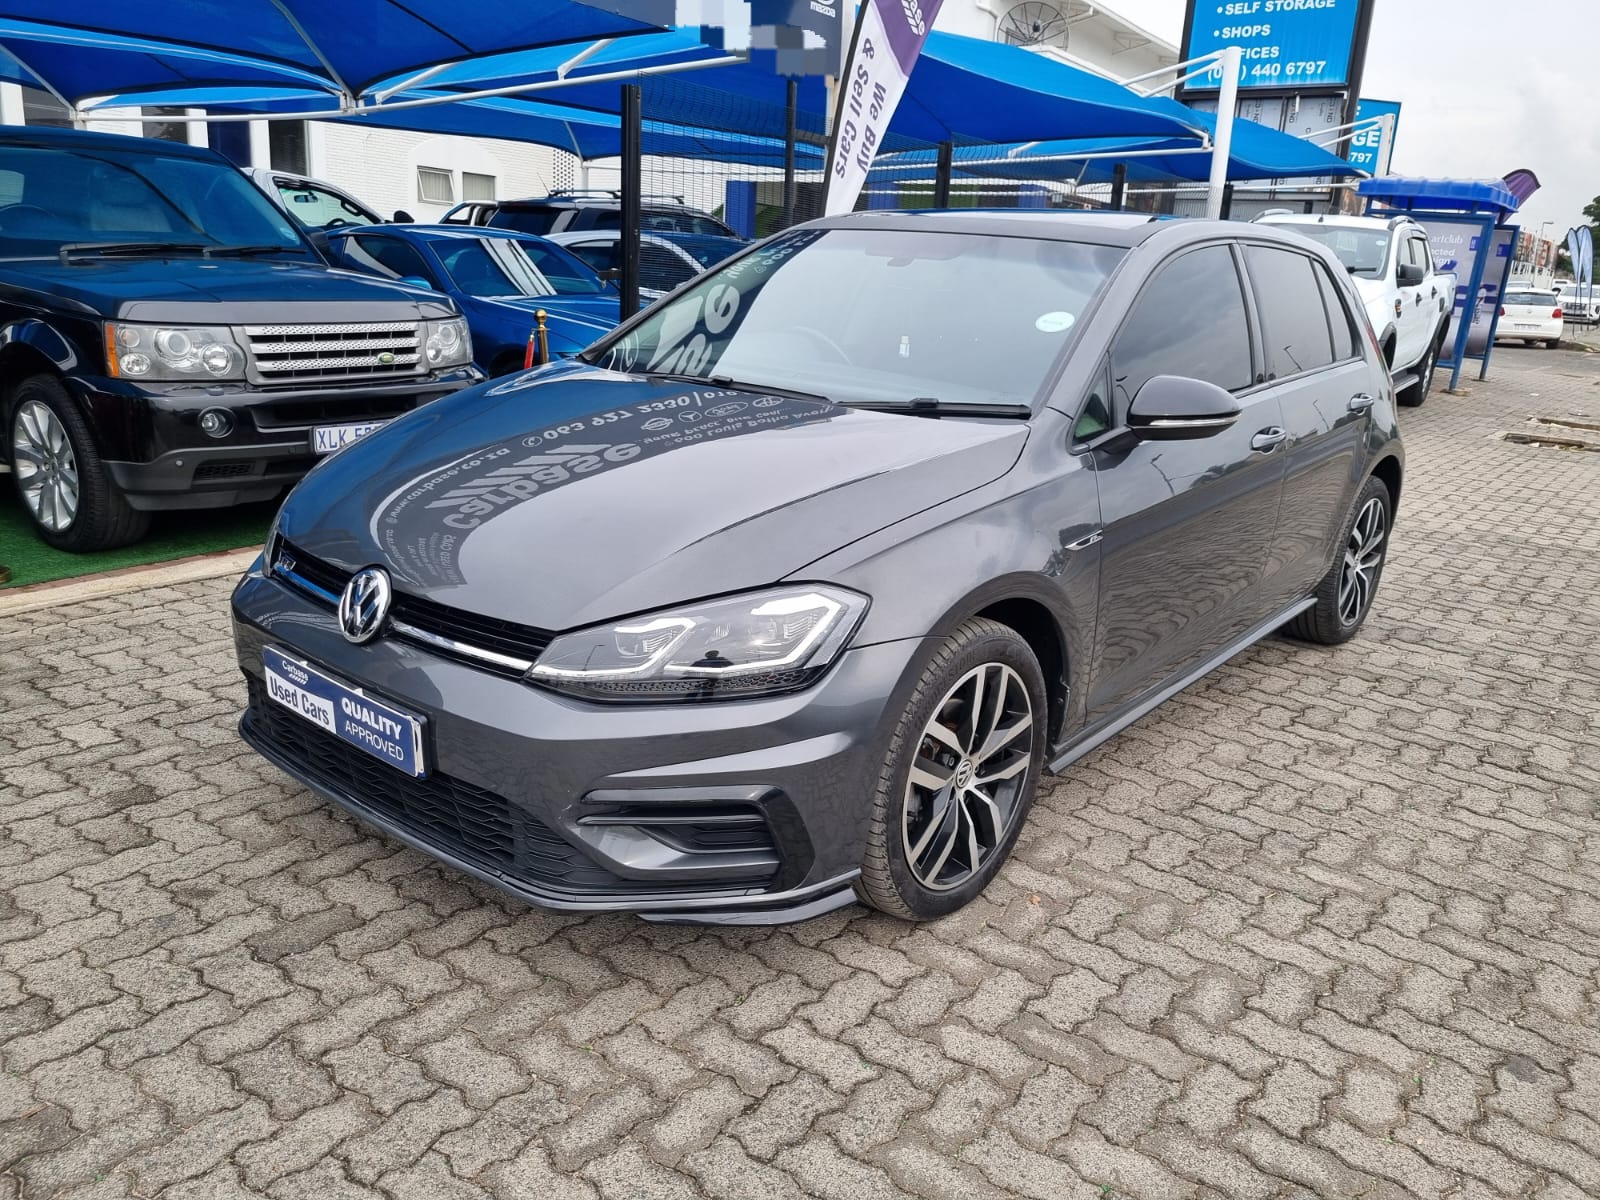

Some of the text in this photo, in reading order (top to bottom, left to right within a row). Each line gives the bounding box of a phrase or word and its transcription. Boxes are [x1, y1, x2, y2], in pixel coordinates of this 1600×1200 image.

[810, 1, 836, 18] mazda
[1225, 2, 1261, 16] SELF
[1222, 24, 1271, 38] SHOPS
[1251, 64, 1281, 77] 440
[1285, 60, 1327, 76] 6797
[835, 37, 875, 179] & Sell Cars
[856, 81, 887, 174] We Buy
[282, 660, 309, 682] Carbase
[269, 675, 330, 726] Used Cars
[341, 697, 403, 740] QUALITY
[344, 722, 404, 762] APPROVED
